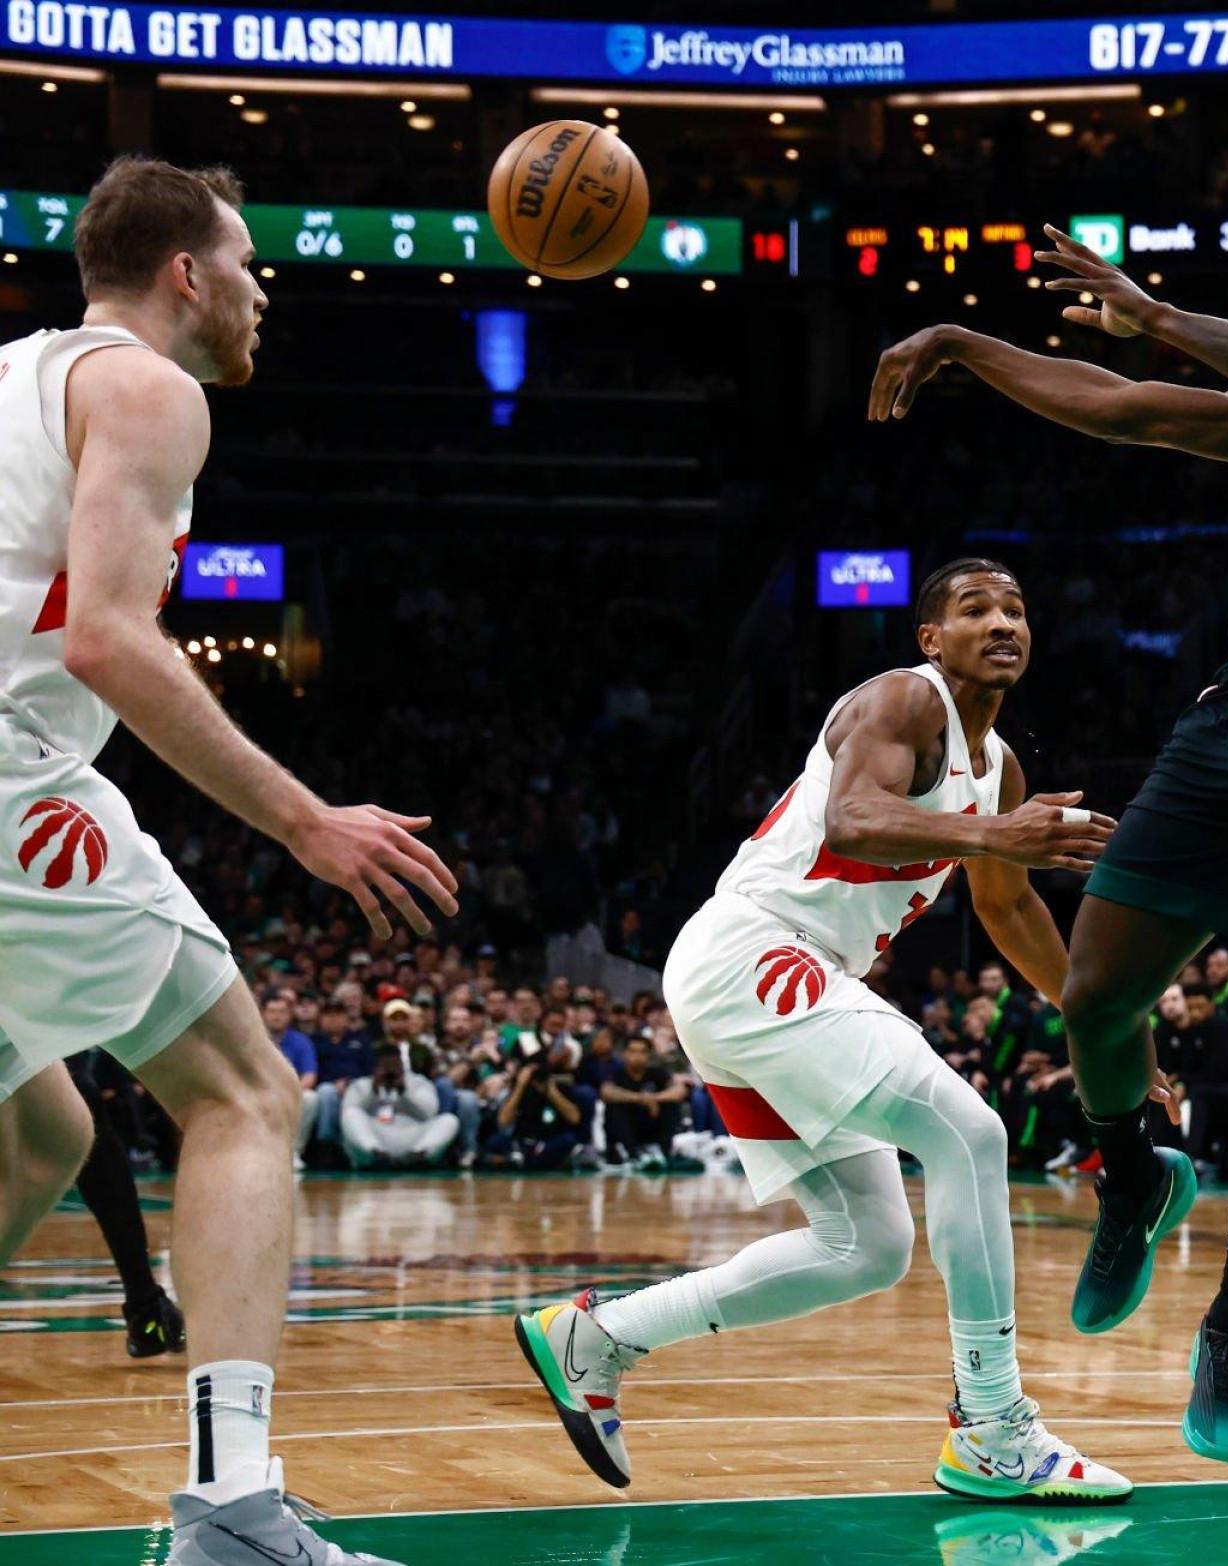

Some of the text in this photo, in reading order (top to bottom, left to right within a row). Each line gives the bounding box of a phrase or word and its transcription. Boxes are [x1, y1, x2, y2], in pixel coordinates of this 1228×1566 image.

[8, 0, 453, 68] GOTTA GET GLASSMAN
[515, 128, 580, 218] Wilson
[45, 217, 64, 242] 7
[1129, 222, 1196, 251] Bank
[296, 230, 475, 261] 0/6 0 1
